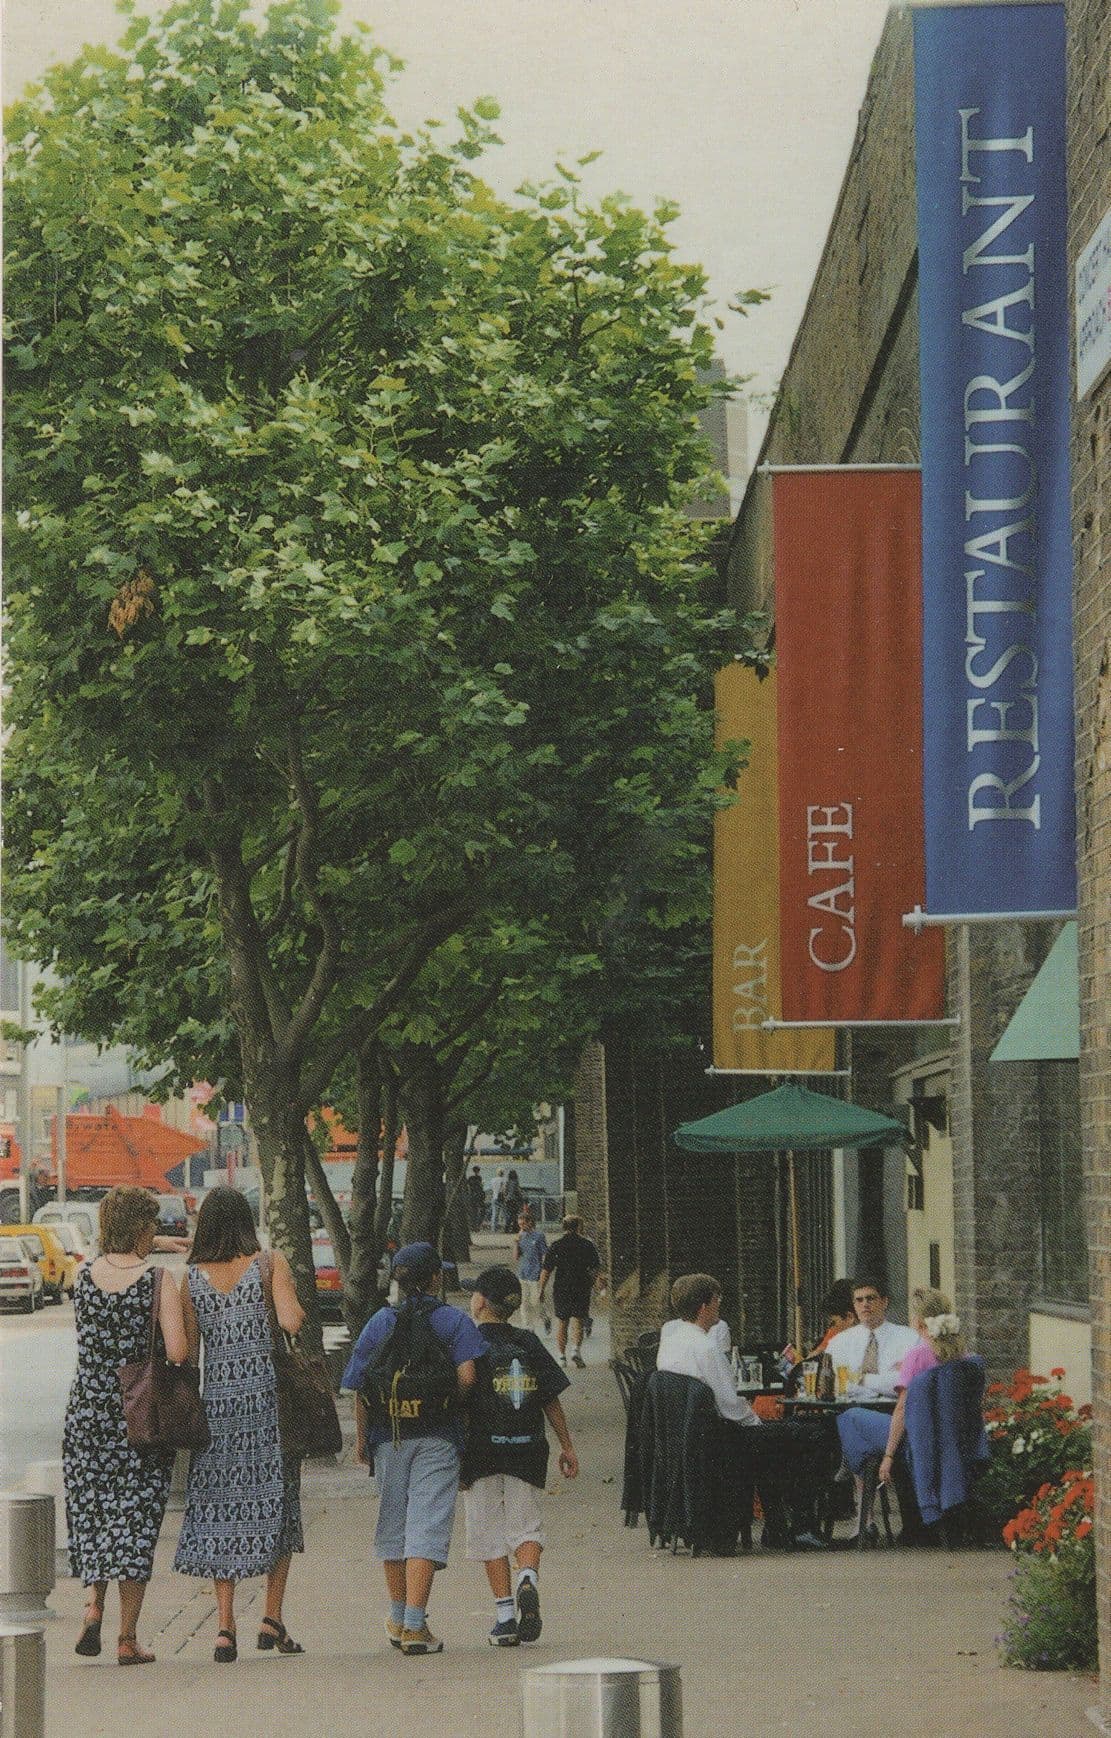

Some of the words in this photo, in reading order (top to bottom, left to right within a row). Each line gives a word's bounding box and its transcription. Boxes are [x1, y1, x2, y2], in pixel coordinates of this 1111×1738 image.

[958, 106, 1042, 832] RESTAURANT
[806, 803, 857, 973] CAFE
[734, 940, 770, 1032] BAR
